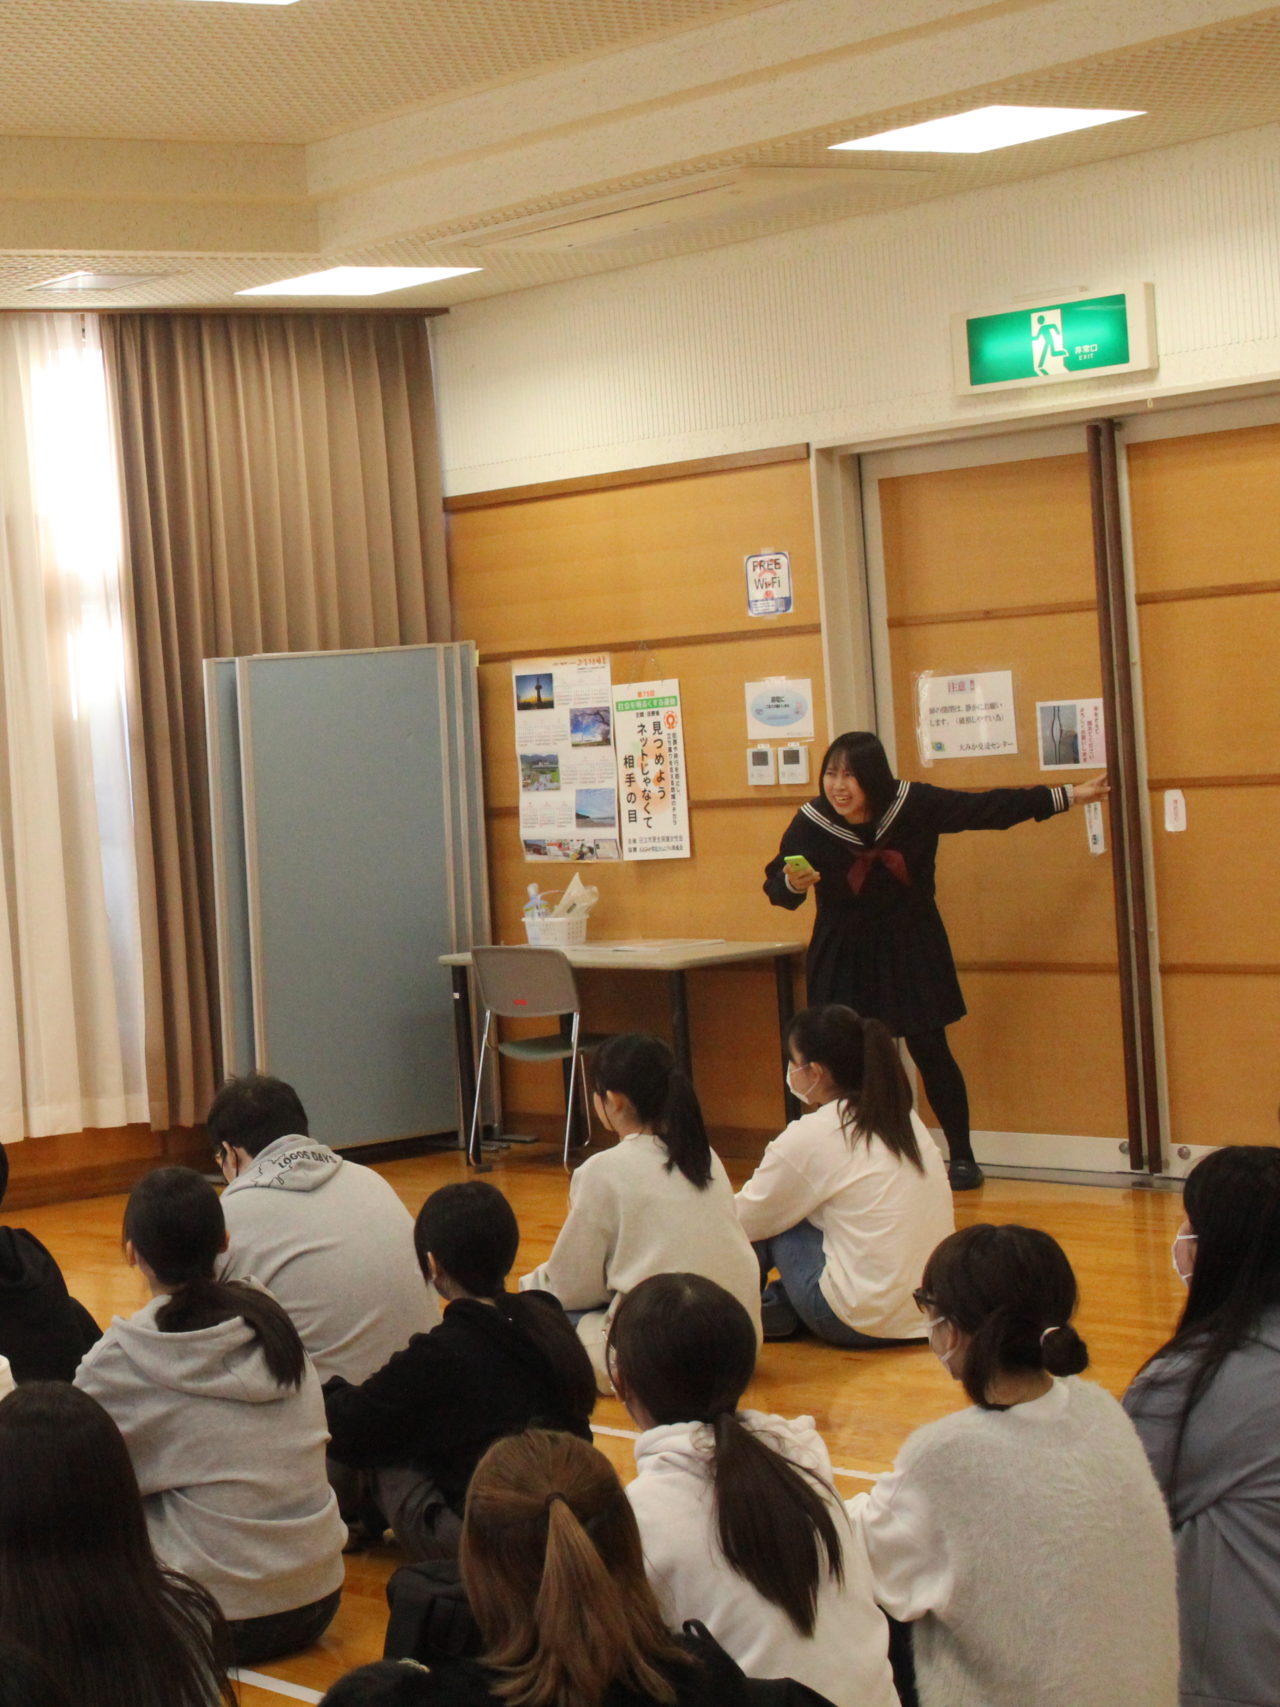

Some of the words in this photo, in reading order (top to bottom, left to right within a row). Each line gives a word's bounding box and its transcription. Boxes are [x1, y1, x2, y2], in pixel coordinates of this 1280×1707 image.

[1074, 344, 1098, 354] 非常口
[1078, 353, 1094, 361] EXIT
[752, 558, 782, 572] FREE
[754, 576, 781, 590] Wi-Fi
[652, 721, 666, 800] 見つめよう
[637, 723, 653, 829] ネットじゃなくて
[623, 755, 637, 823] 相手の目
[278, 1150, 310, 1169] LOGOS
[312, 1150, 337, 1164] DAYS
